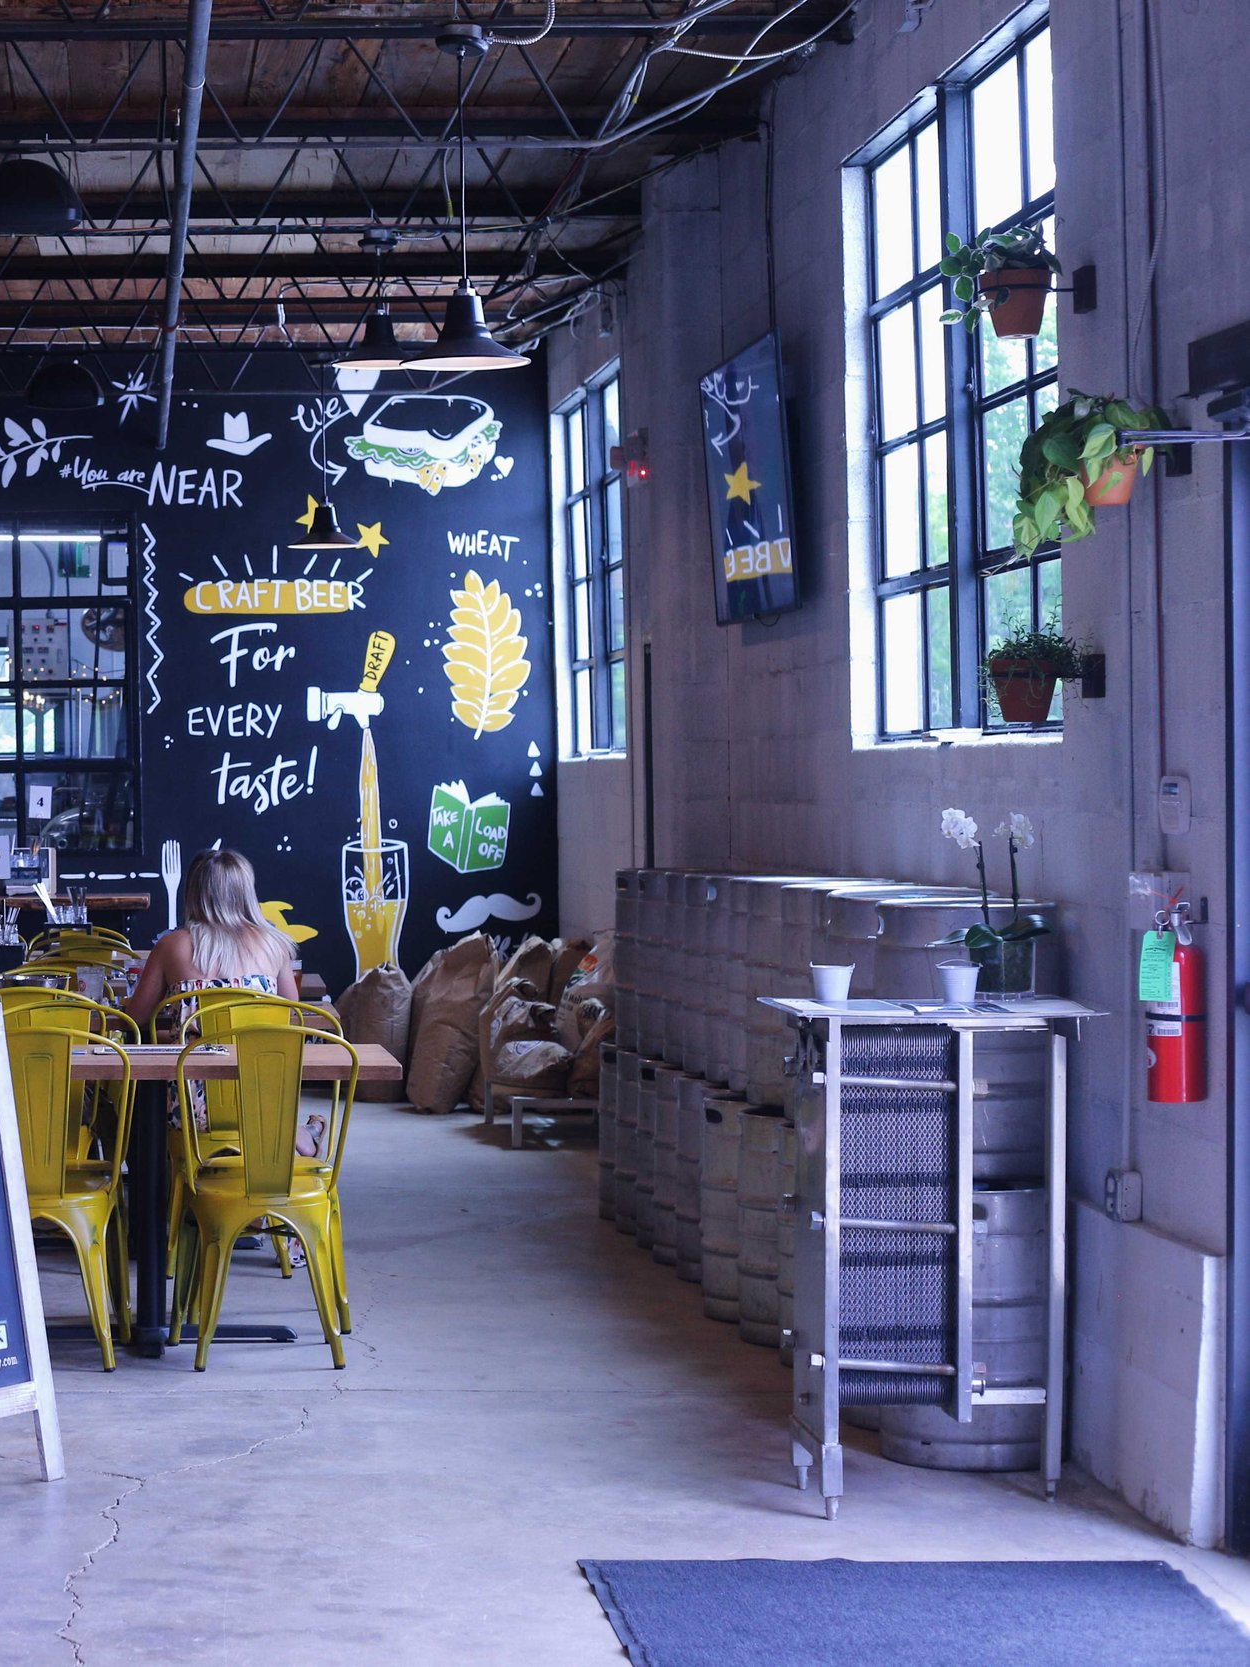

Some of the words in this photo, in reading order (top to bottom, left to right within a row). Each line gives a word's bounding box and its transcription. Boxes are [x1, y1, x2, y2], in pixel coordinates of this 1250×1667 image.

[290, 397, 342, 433] We
[116, 470, 146, 483] are
[148, 461, 243, 509] NEAR
[447, 530, 520, 562] WHEAT
[195, 579, 288, 610] CRAFT
[294, 579, 366, 610] BEER
[210, 622, 295, 687] For
[363, 631, 390, 681] DRAFT
[187, 702, 282, 739] EVERY
[210, 745, 318, 815] taste!
[36, 797, 44, 807] 4
[431, 806, 459, 826] TAKE
[443, 830, 454, 849] A
[475, 817, 507, 842] LOAD
[478, 842, 505, 861] OFF
